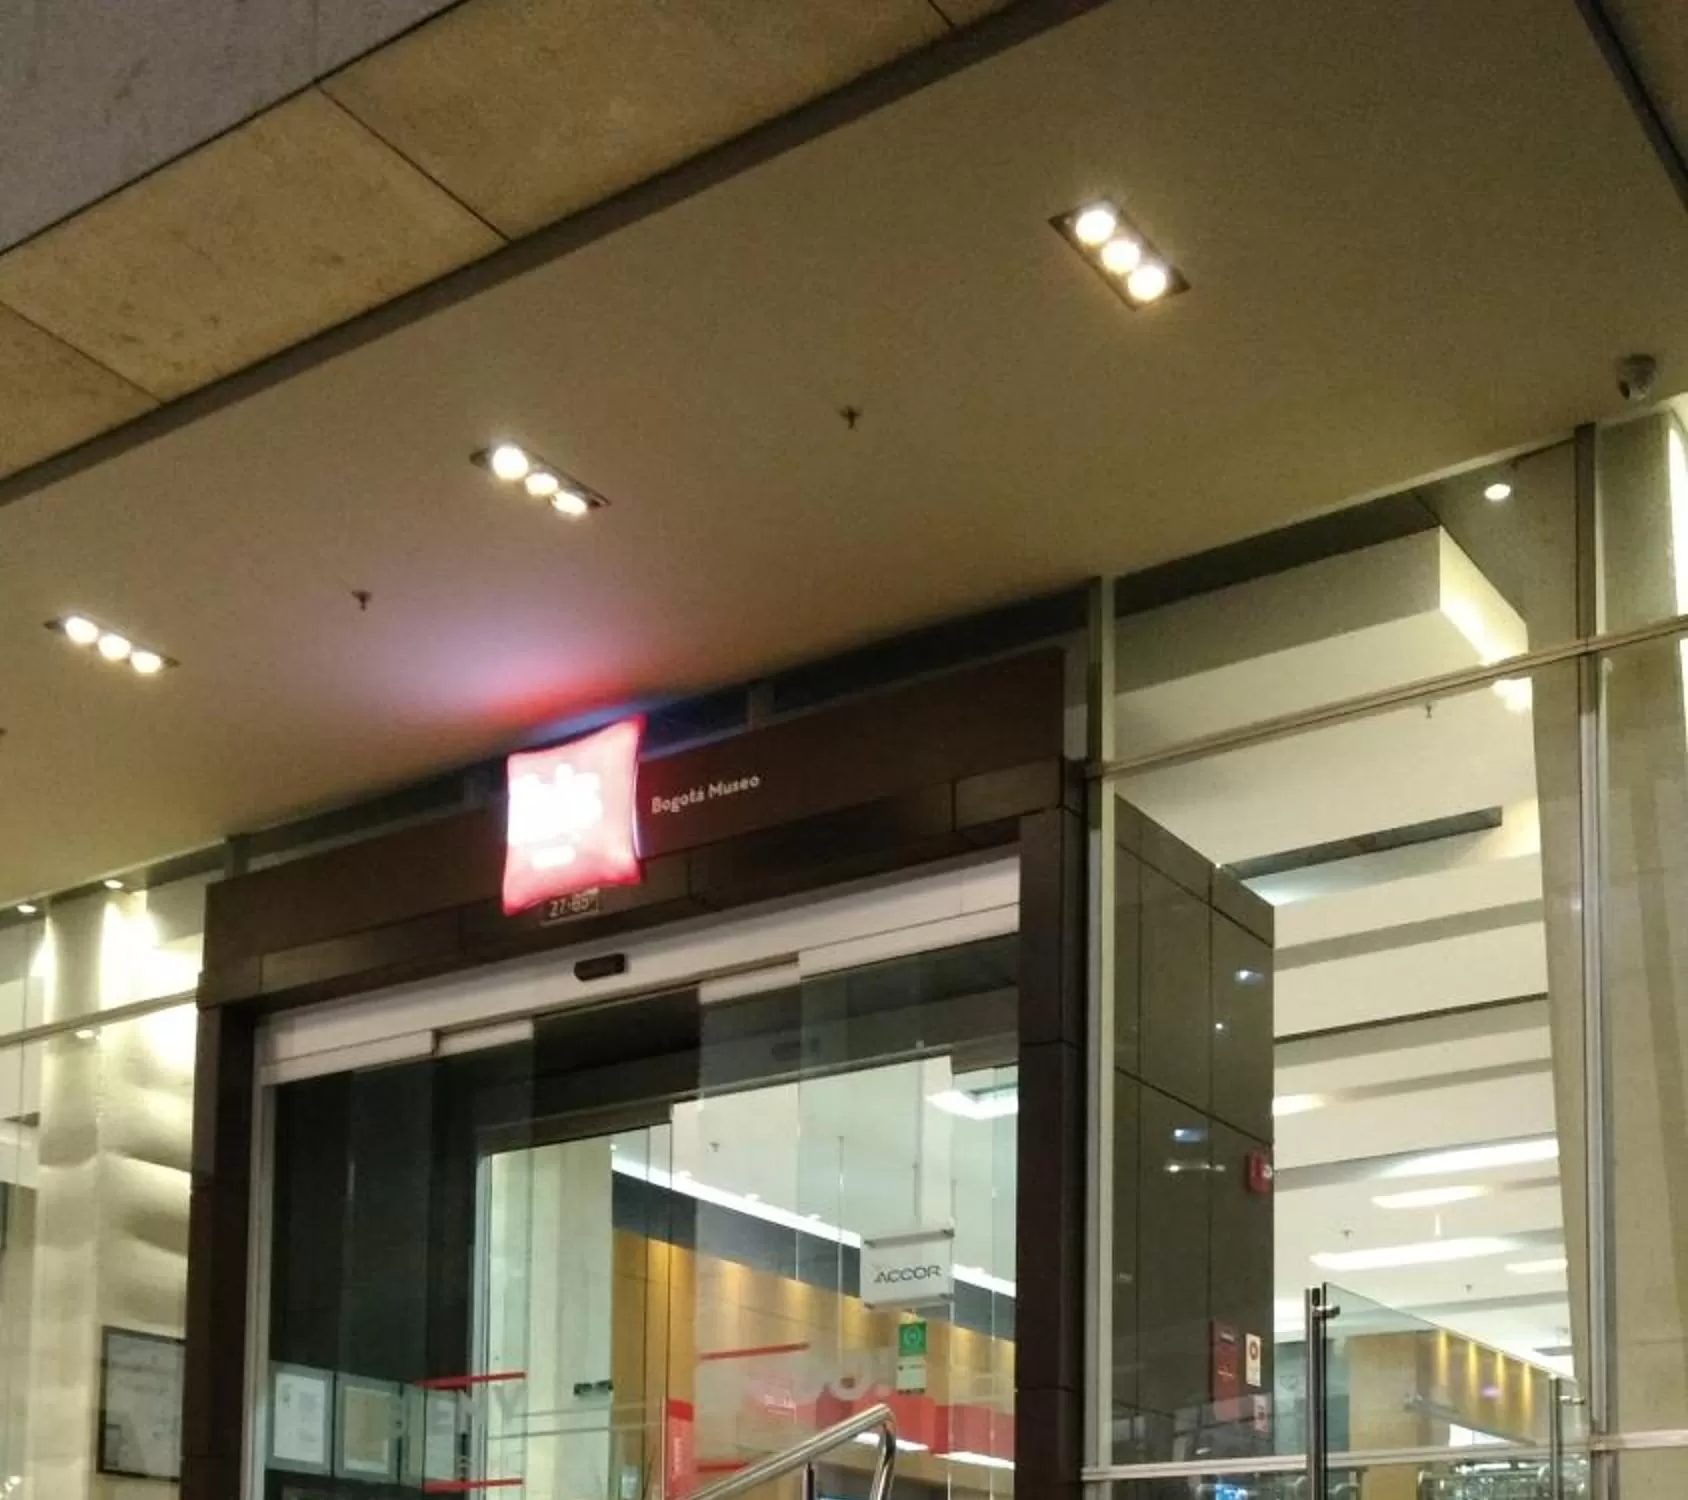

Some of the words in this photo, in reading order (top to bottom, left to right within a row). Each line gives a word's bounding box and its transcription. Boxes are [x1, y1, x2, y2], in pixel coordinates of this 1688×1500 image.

[651, 787, 705, 815] Bogotá
[708, 775, 760, 799] Museo
[874, 1264, 943, 1284] ACCOR
